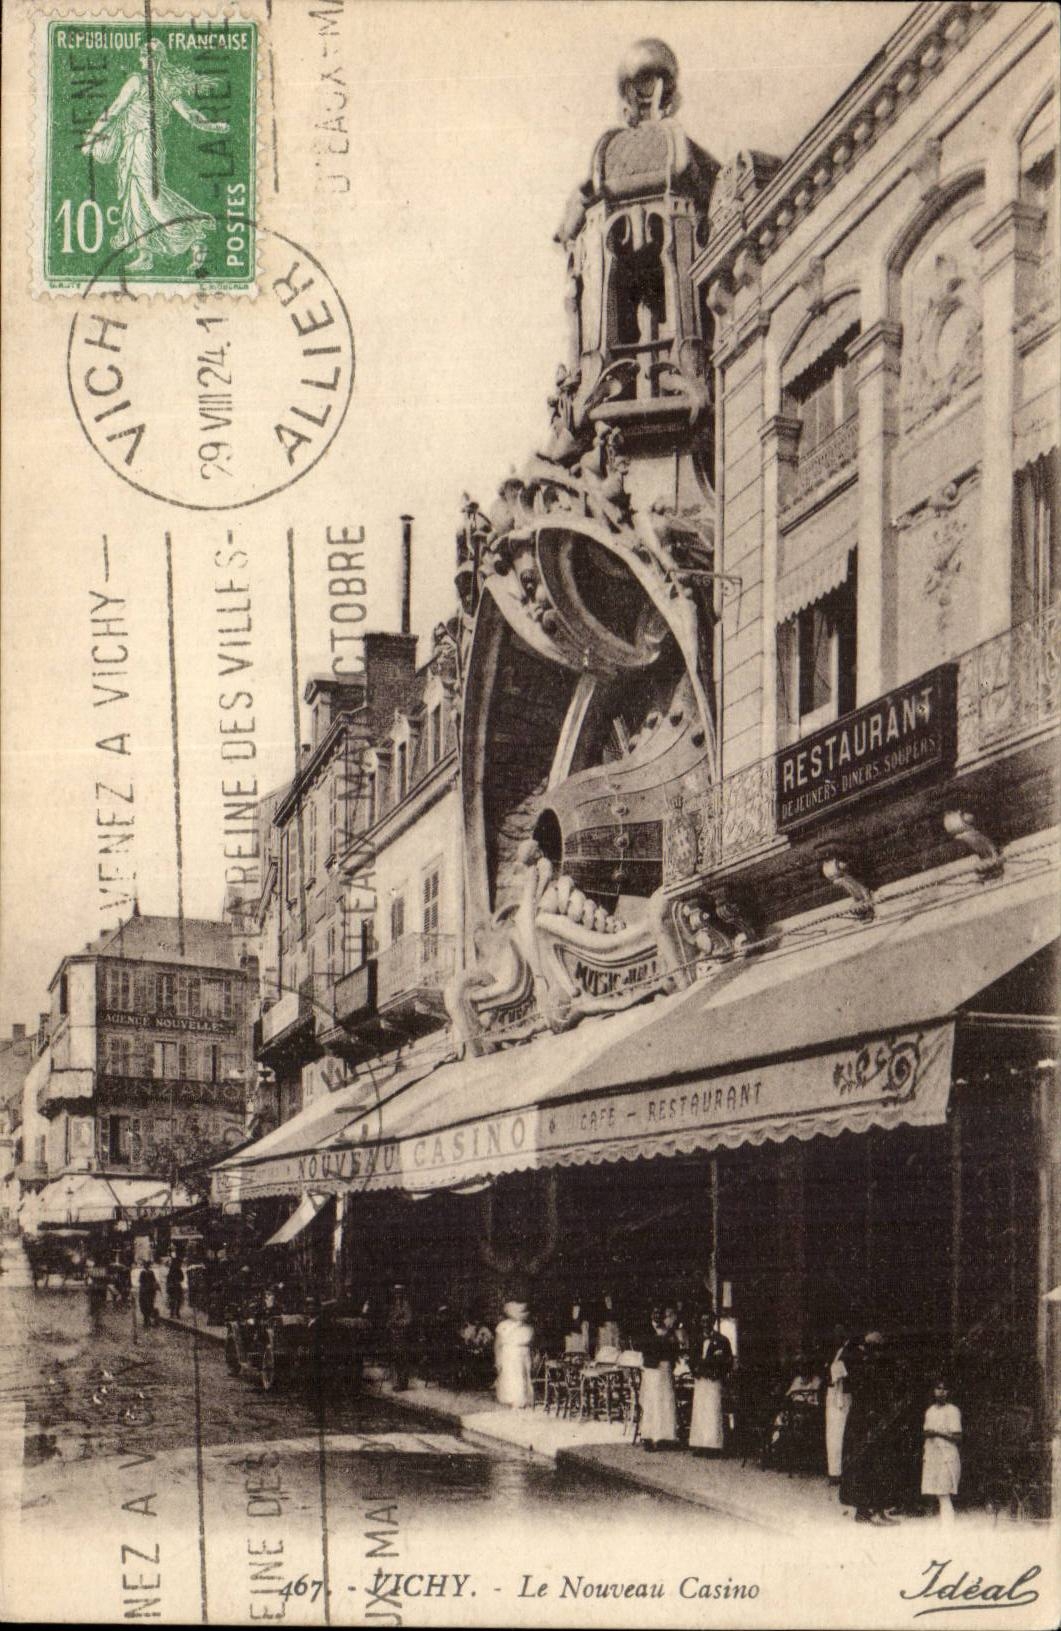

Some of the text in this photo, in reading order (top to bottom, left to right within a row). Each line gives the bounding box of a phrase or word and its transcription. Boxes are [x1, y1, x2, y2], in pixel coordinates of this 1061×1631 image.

[226, 182, 246, 268] POSTES
[84, 265, 146, 465] VICHY
[272, 261, 342, 466] ALLIER
[89, 590, 136, 911] VENEZ A VICHY
[219, 691, 257, 760] DES
[783, 687, 933, 793] RESTAURANT
[222, 780, 260, 886] REINE
[413, 1116, 526, 1168] CASINO
[648, 1081, 763, 1123] RESTAURANT
[121, 1492, 158, 1517] A
